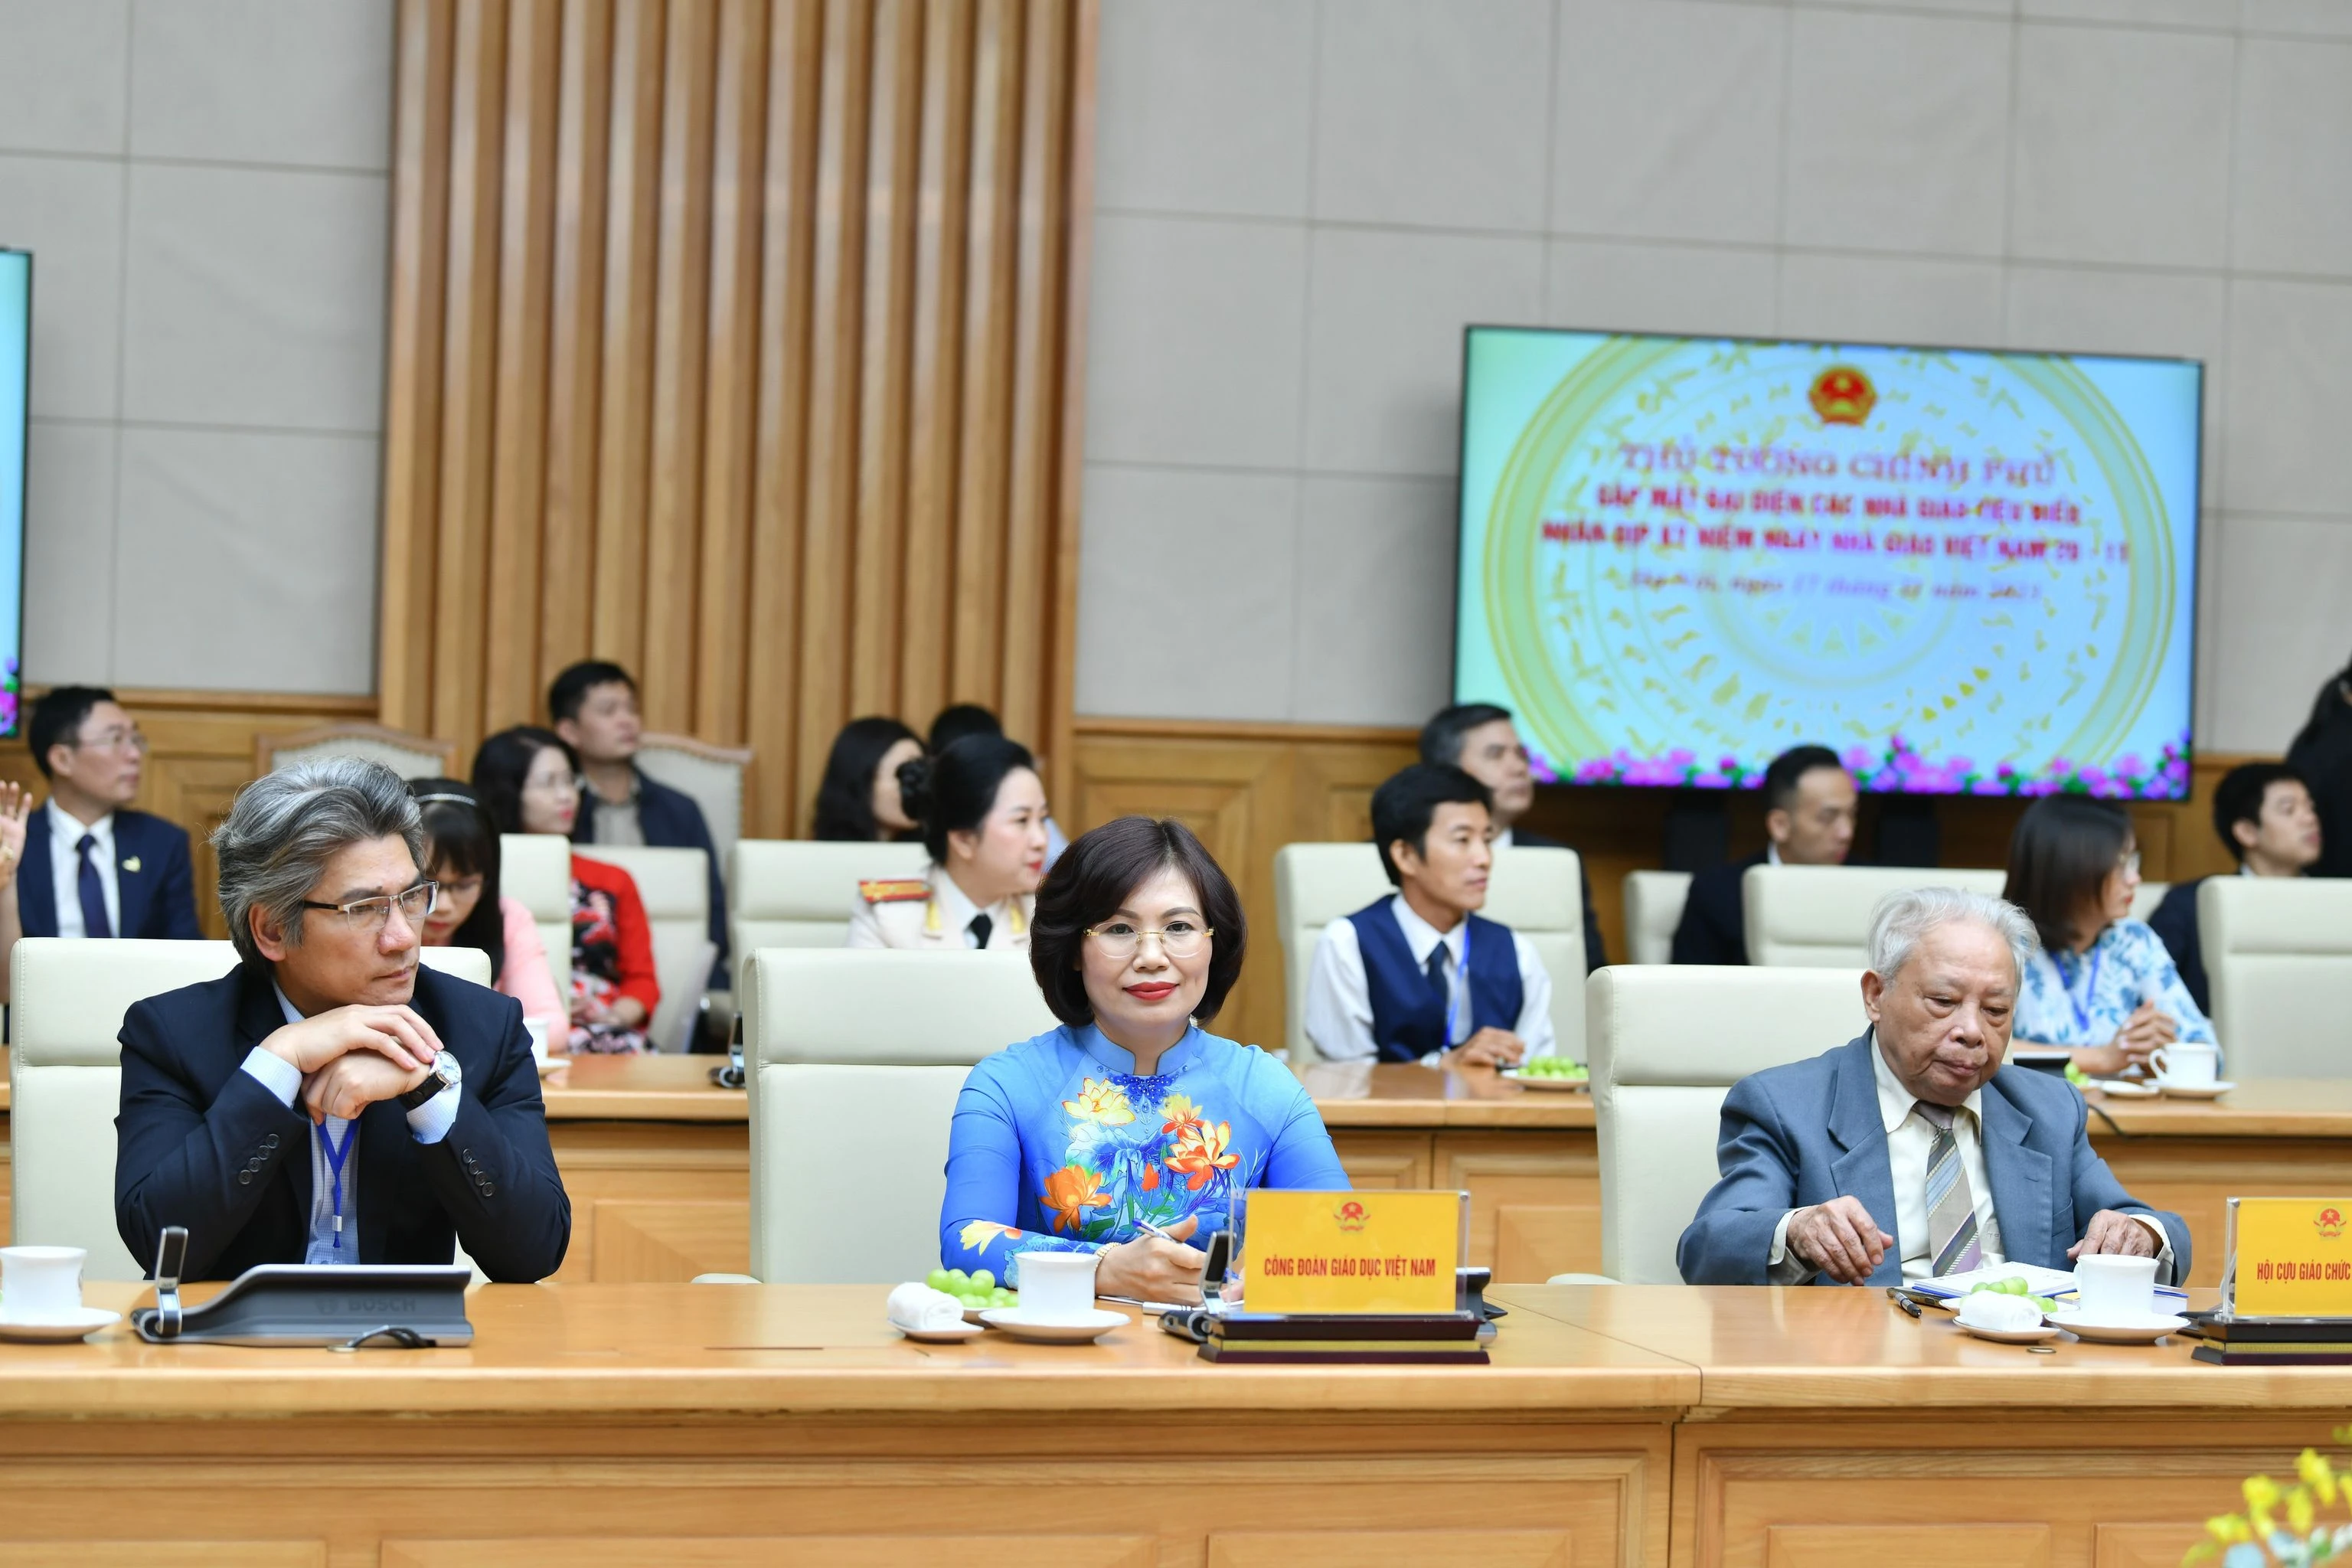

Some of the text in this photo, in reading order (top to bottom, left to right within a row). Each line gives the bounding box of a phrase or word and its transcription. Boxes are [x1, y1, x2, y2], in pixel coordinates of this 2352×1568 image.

[1264, 1254, 1436, 1281] CÔNG ĐOÀN GIÁO DỤC VIỆT NAM
[2256, 1259, 2351, 1285] HỘI CỰU GIÁO CHỨC
[347, 1296, 416, 1312] BOSCH
